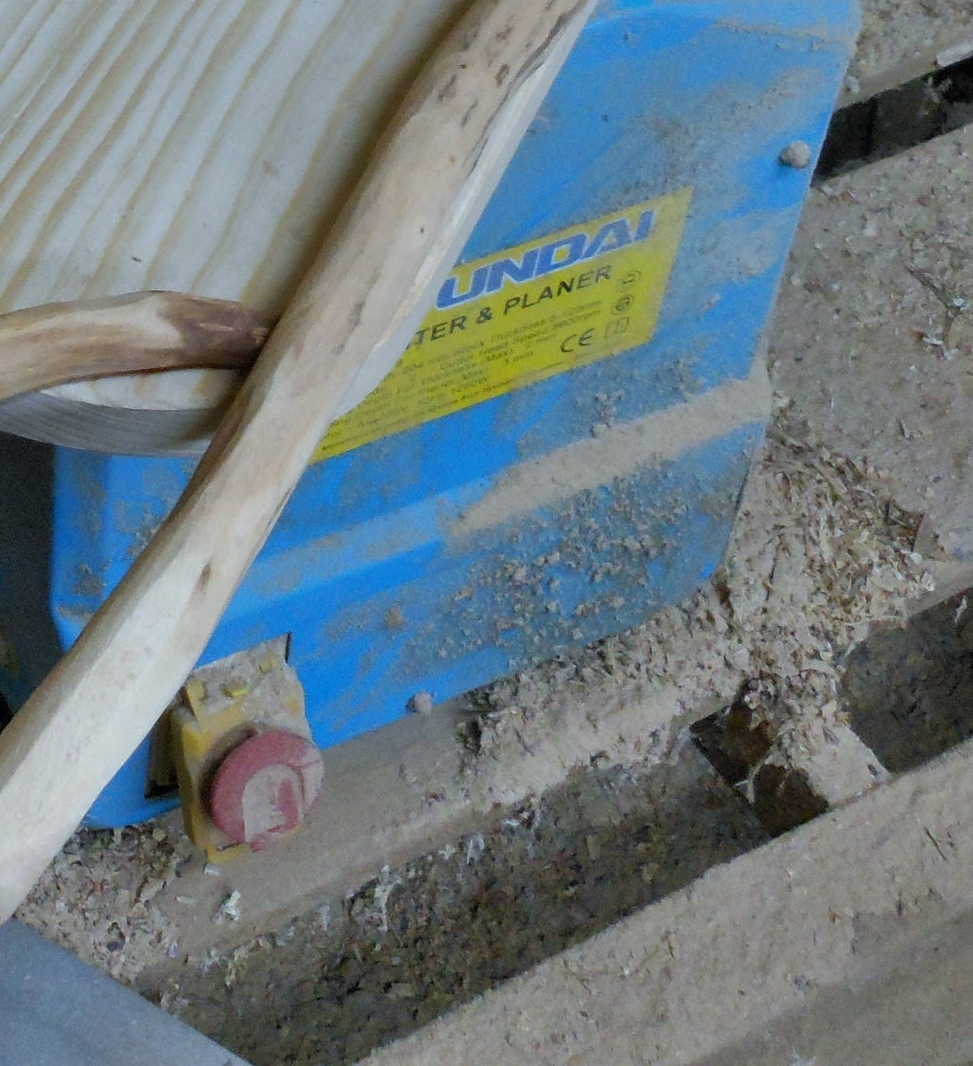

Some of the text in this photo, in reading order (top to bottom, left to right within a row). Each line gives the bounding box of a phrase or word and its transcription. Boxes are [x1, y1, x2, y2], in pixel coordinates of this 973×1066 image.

[437, 210, 656, 308] UNDAI
[475, 305, 492, 325] &
[503, 263, 612, 315] PLANER
[559, 327, 594, 355] CE
